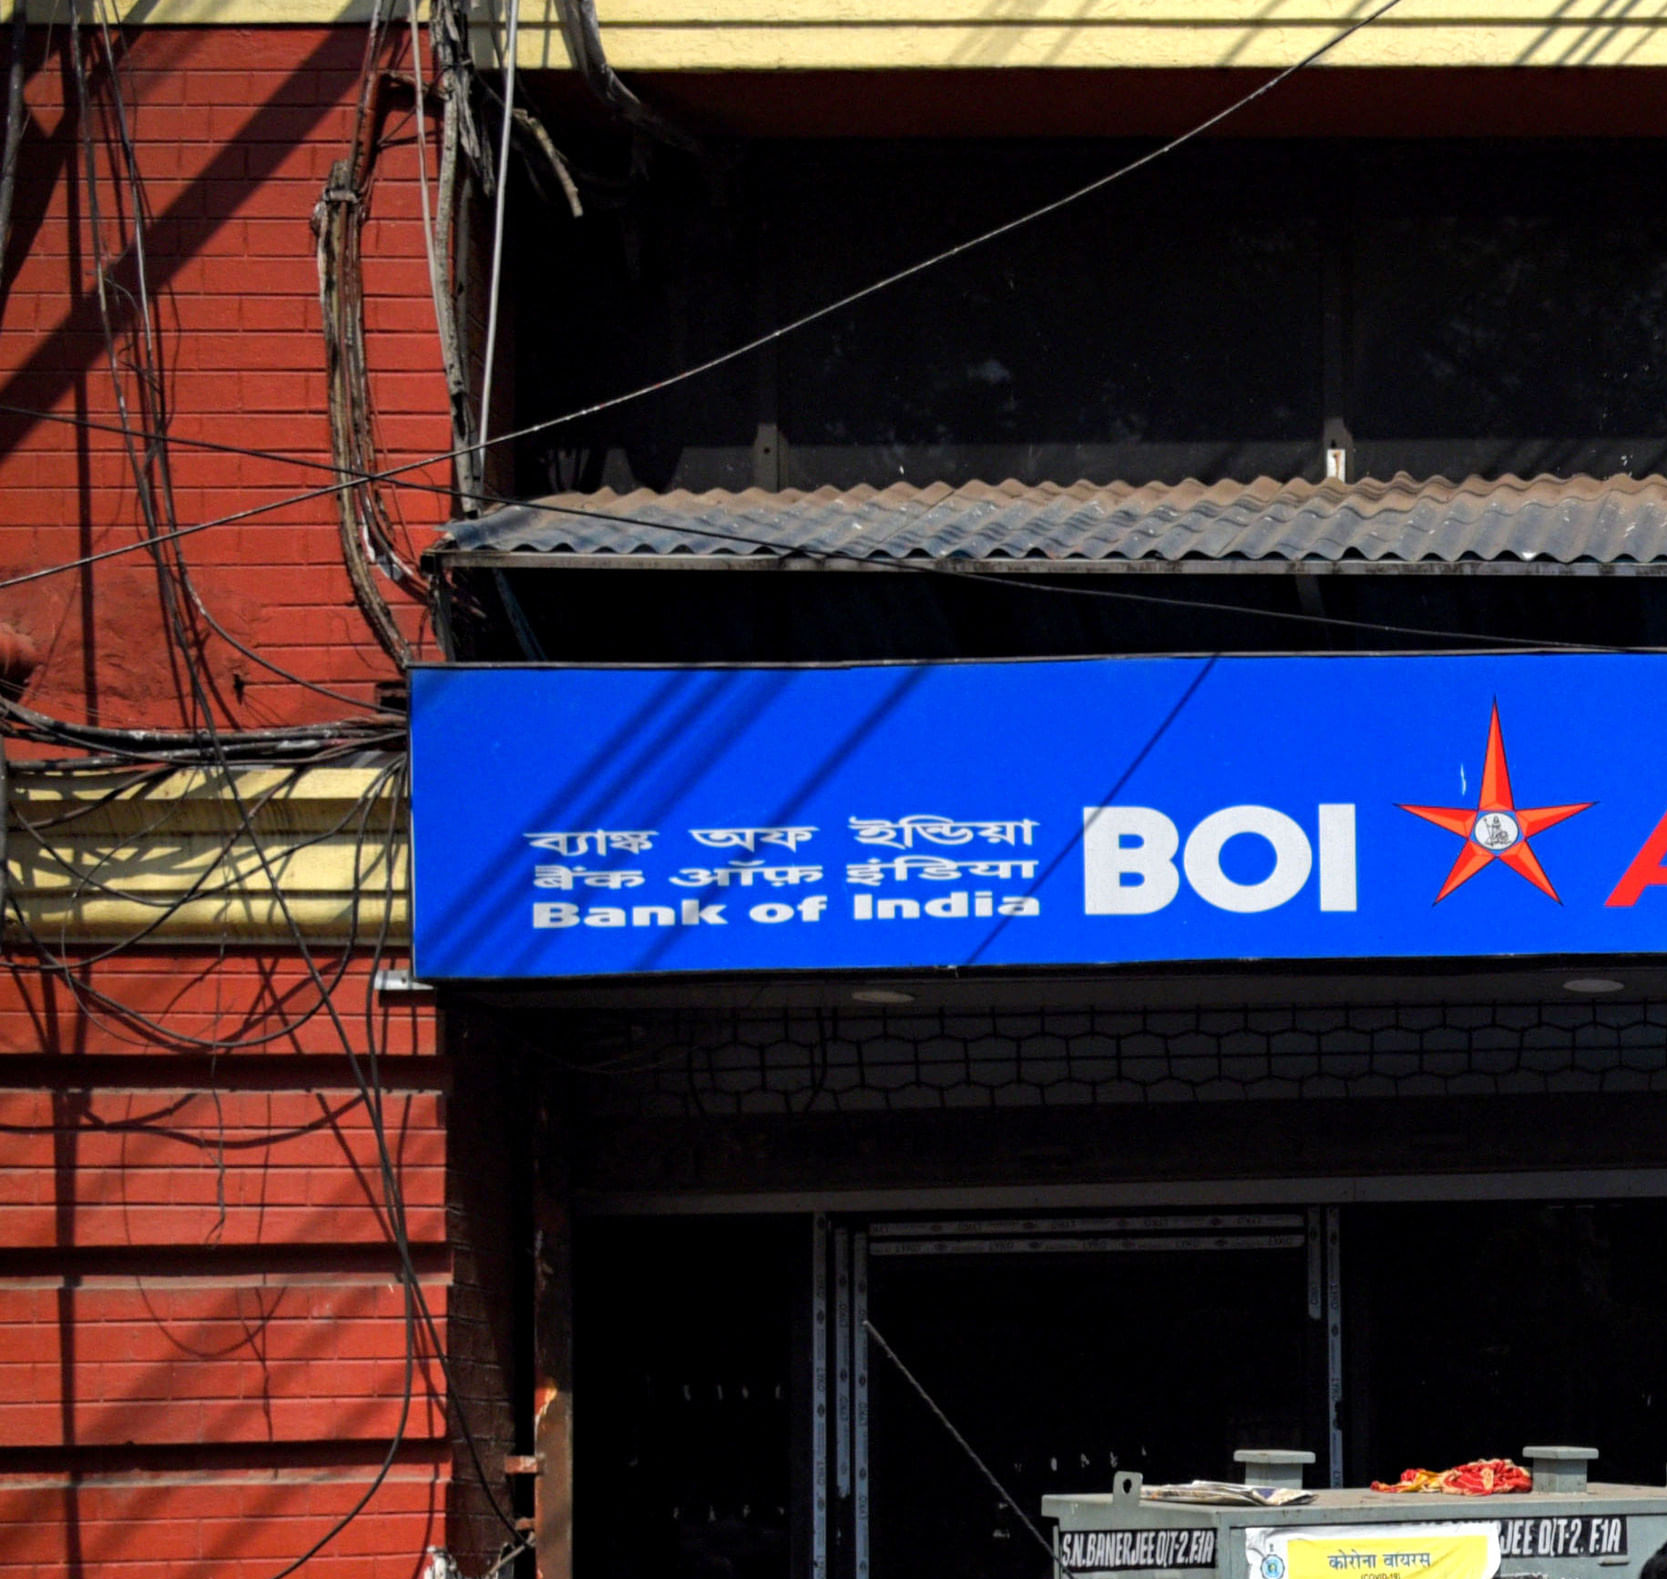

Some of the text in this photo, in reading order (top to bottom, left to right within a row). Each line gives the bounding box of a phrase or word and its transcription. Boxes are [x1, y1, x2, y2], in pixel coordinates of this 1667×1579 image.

[525, 815, 1040, 856] ব্যাঙ্ক অফ ইন্ডিয়া
[534, 863, 645, 890] बैंक
[845, 855, 1038, 885] इंडिया
[1083, 803, 1357, 915] BOI
[533, 891, 1040, 928] Bank of India
[1327, 1549, 1377, 1570] कोरोना
